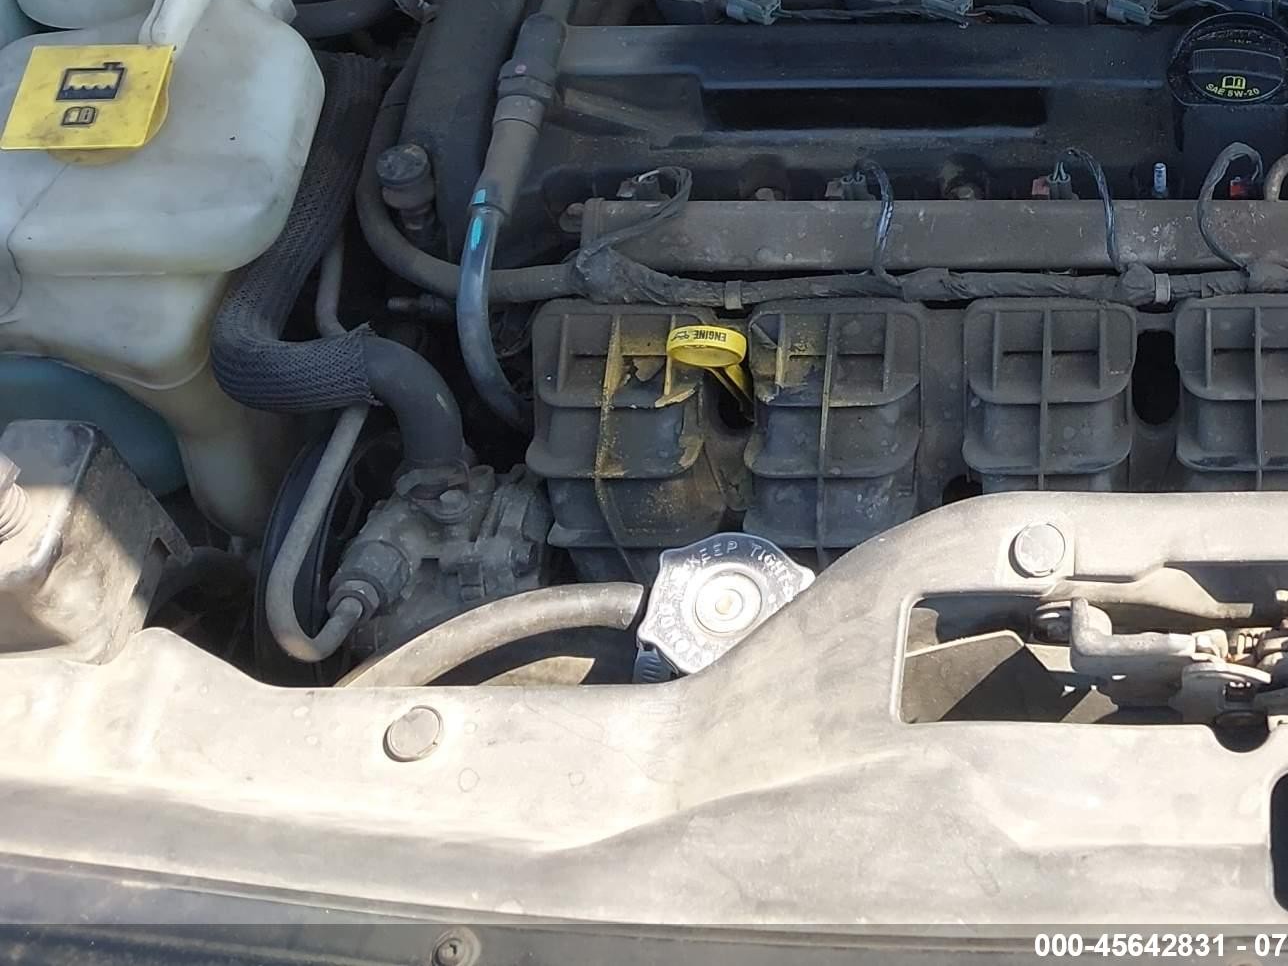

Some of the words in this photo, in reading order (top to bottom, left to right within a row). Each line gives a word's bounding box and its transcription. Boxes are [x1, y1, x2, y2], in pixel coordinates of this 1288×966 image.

[1205, 83, 1226, 96] SAE
[1227, 87, 1260, 98] 5W-20
[693, 329, 727, 343] ENGINE
[685, 540, 738, 568] KEEP
[750, 542, 796, 583] TIGHT
